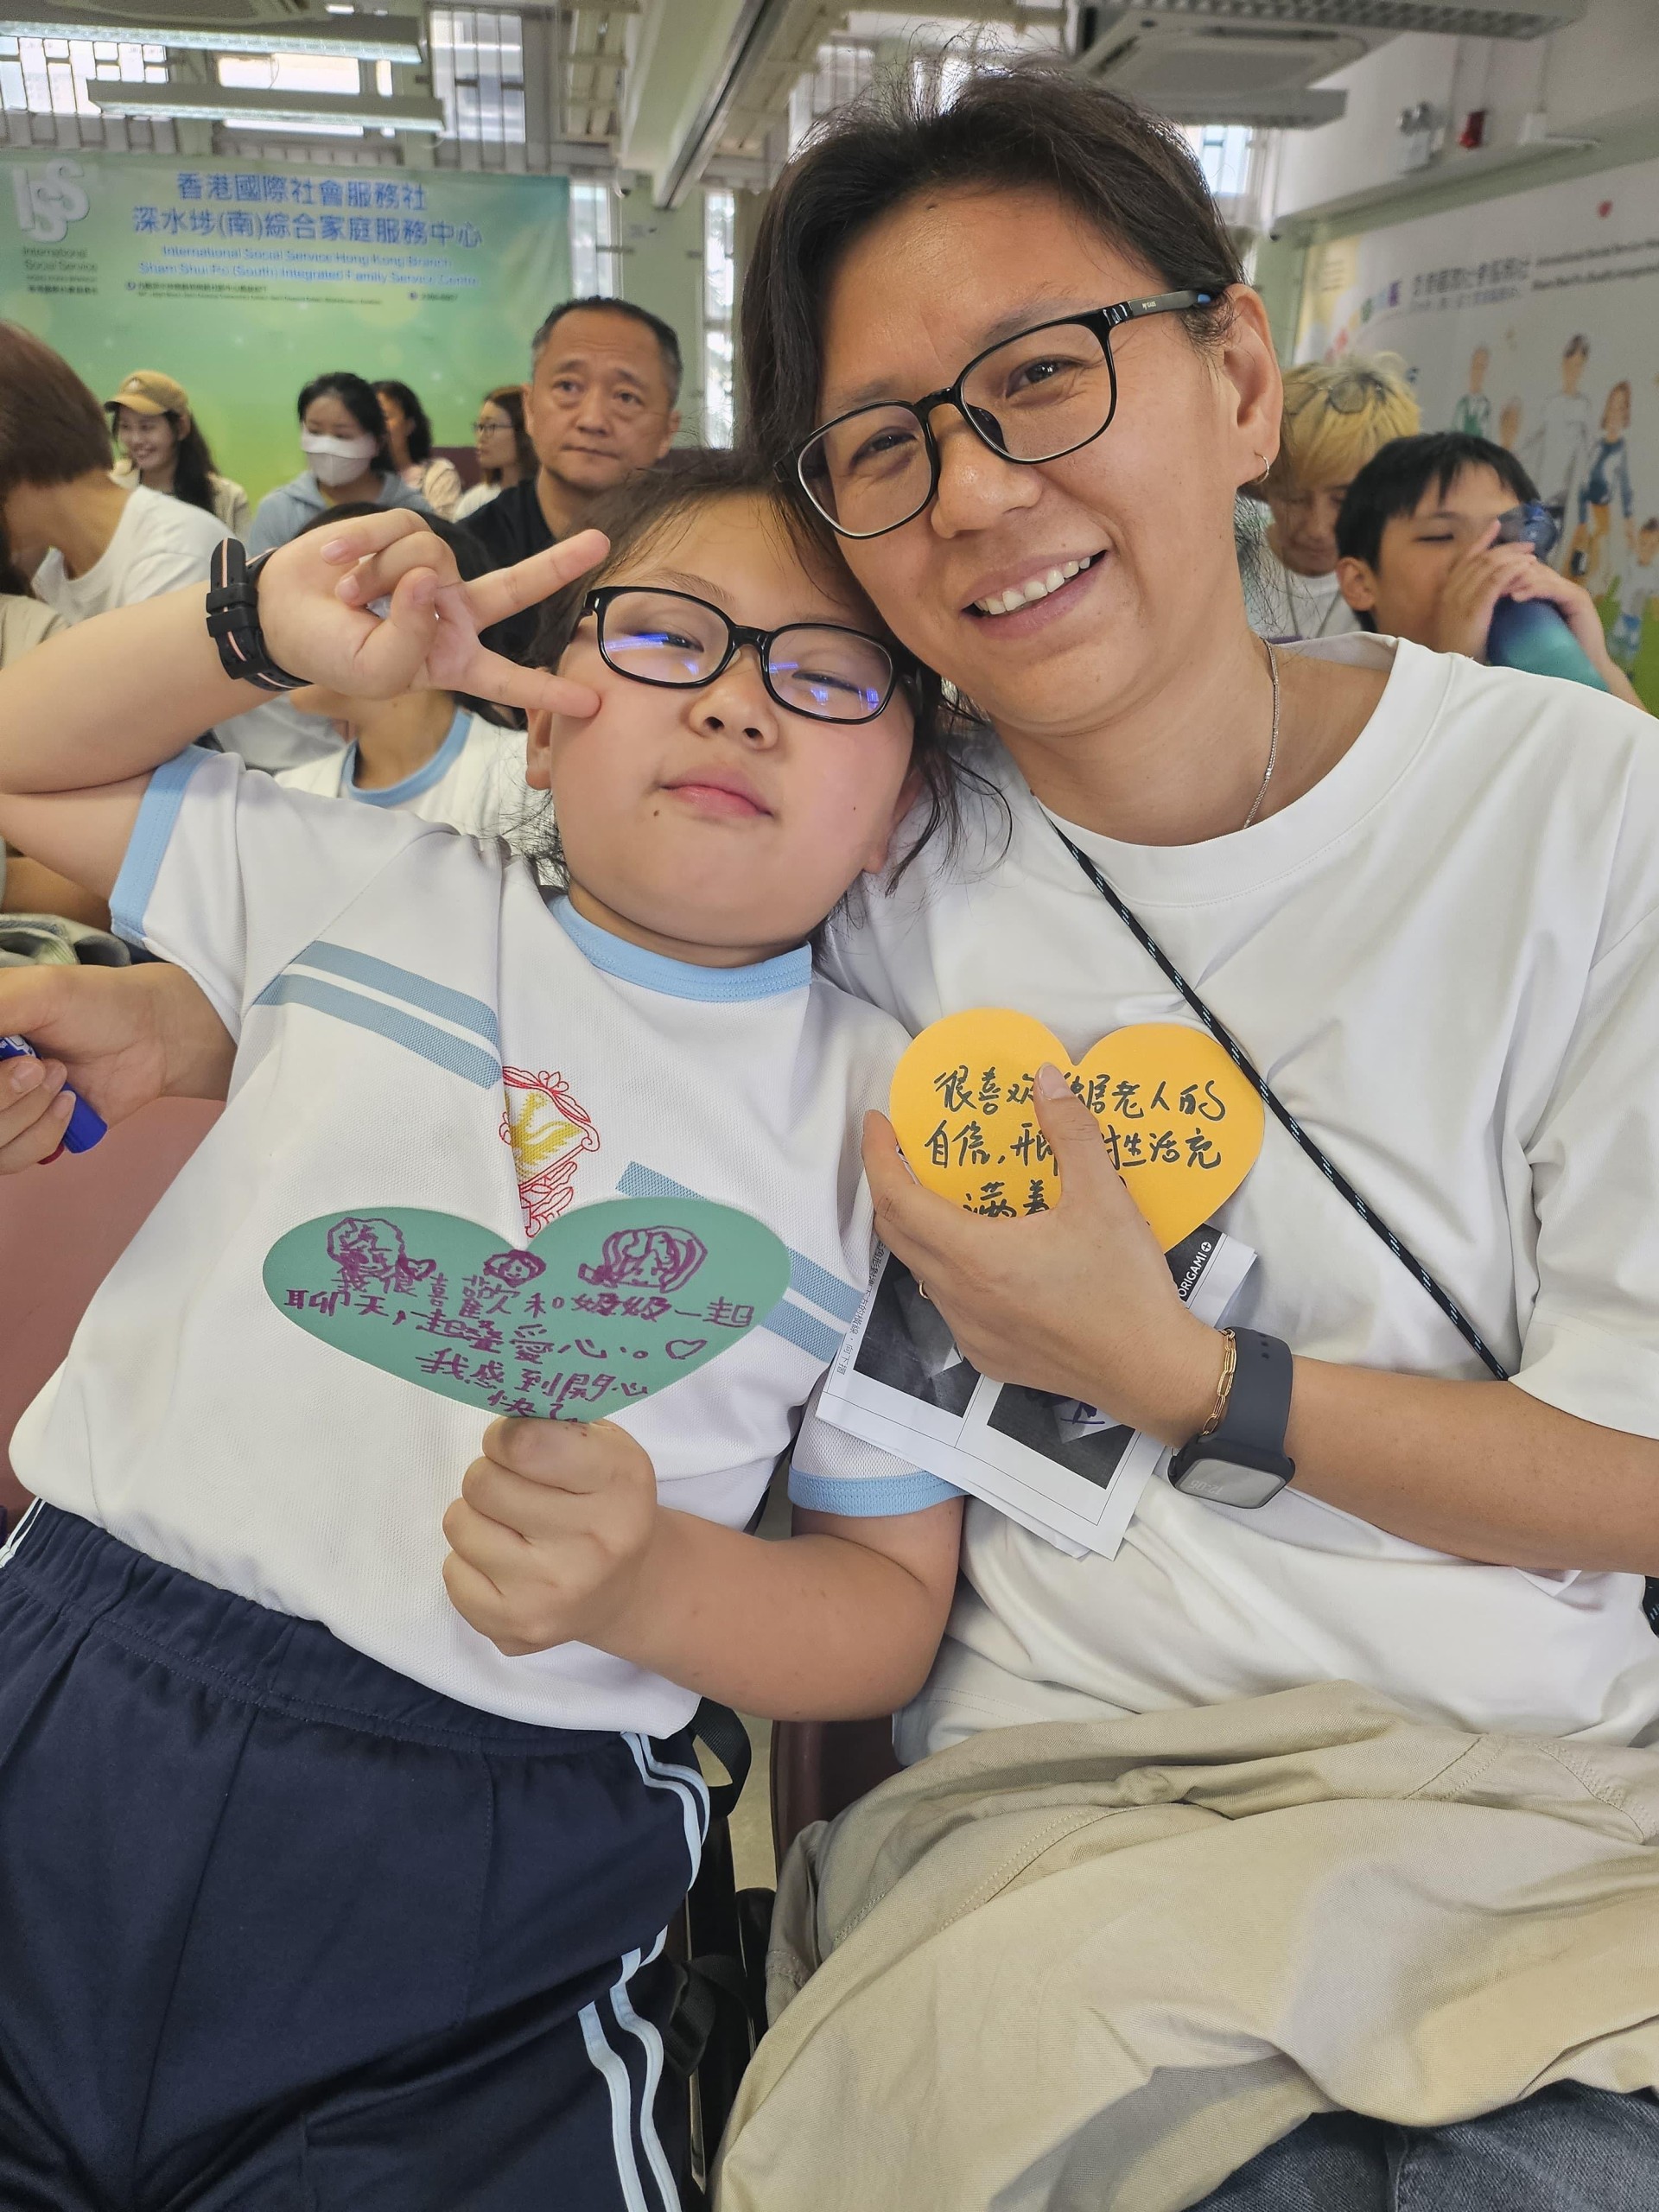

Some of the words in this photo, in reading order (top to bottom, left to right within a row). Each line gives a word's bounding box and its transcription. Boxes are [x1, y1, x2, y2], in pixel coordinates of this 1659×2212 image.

[176, 173, 428, 212] 香港國際社會服務社
[162, 245, 242, 258] International
[245, 247, 283, 260] Social
[287, 250, 333, 263] Service
[336, 251, 369, 267] Hong
[373, 253, 404, 268] Kong
[139, 262, 176, 275] Sham
[181, 264, 208, 276] Shui
[282, 266, 344, 282] Integrated
[346, 269, 388, 284] Family
[1178, 1251, 1207, 1297] ORIGAMI
[1190, 1480, 1224, 1496] 12:05
